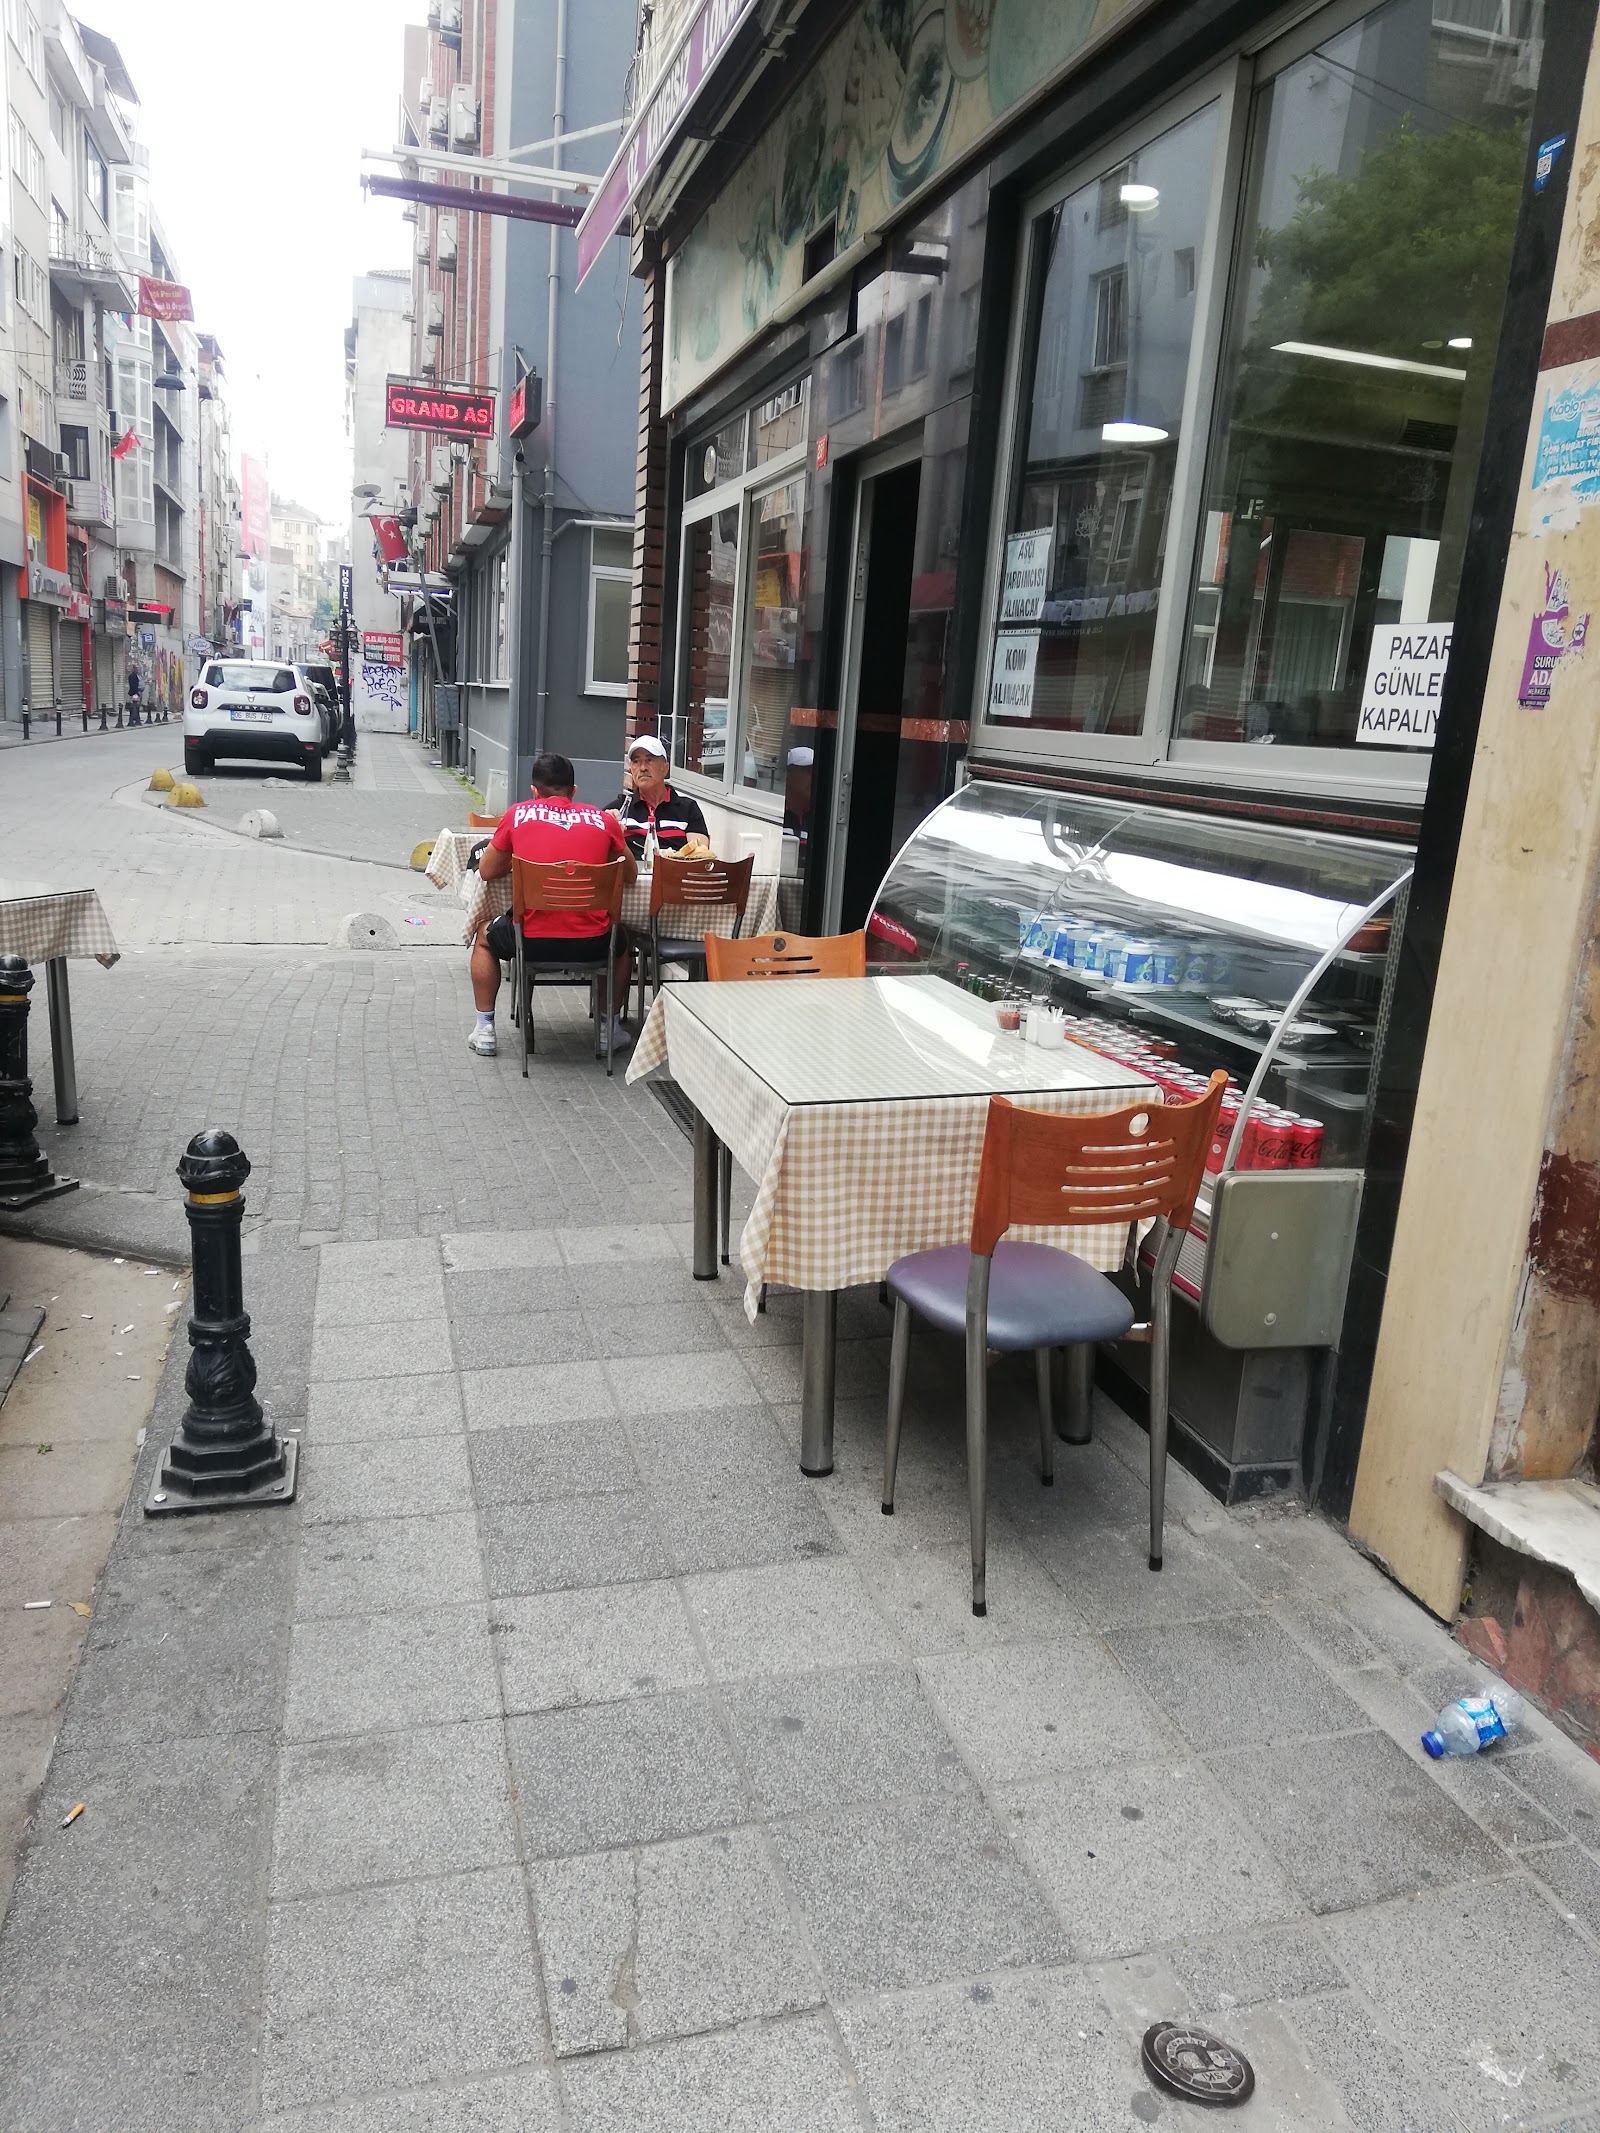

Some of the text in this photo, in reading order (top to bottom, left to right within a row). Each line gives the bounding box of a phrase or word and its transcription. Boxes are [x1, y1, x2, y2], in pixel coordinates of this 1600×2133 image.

[391, 398, 459, 420] GRAND
[463, 406, 489, 424] AS
[341, 569, 350, 607] HOTEL
[1005, 642, 1028, 671] KOMİ
[1374, 666, 1447, 697] GÜNLE
[992, 682, 1032, 707] ALINACAK
[246, 712, 257, 720] BUS
[513, 807, 605, 830] PATRIOTS
[516, 803, 576, 814] ESTABLISHED
